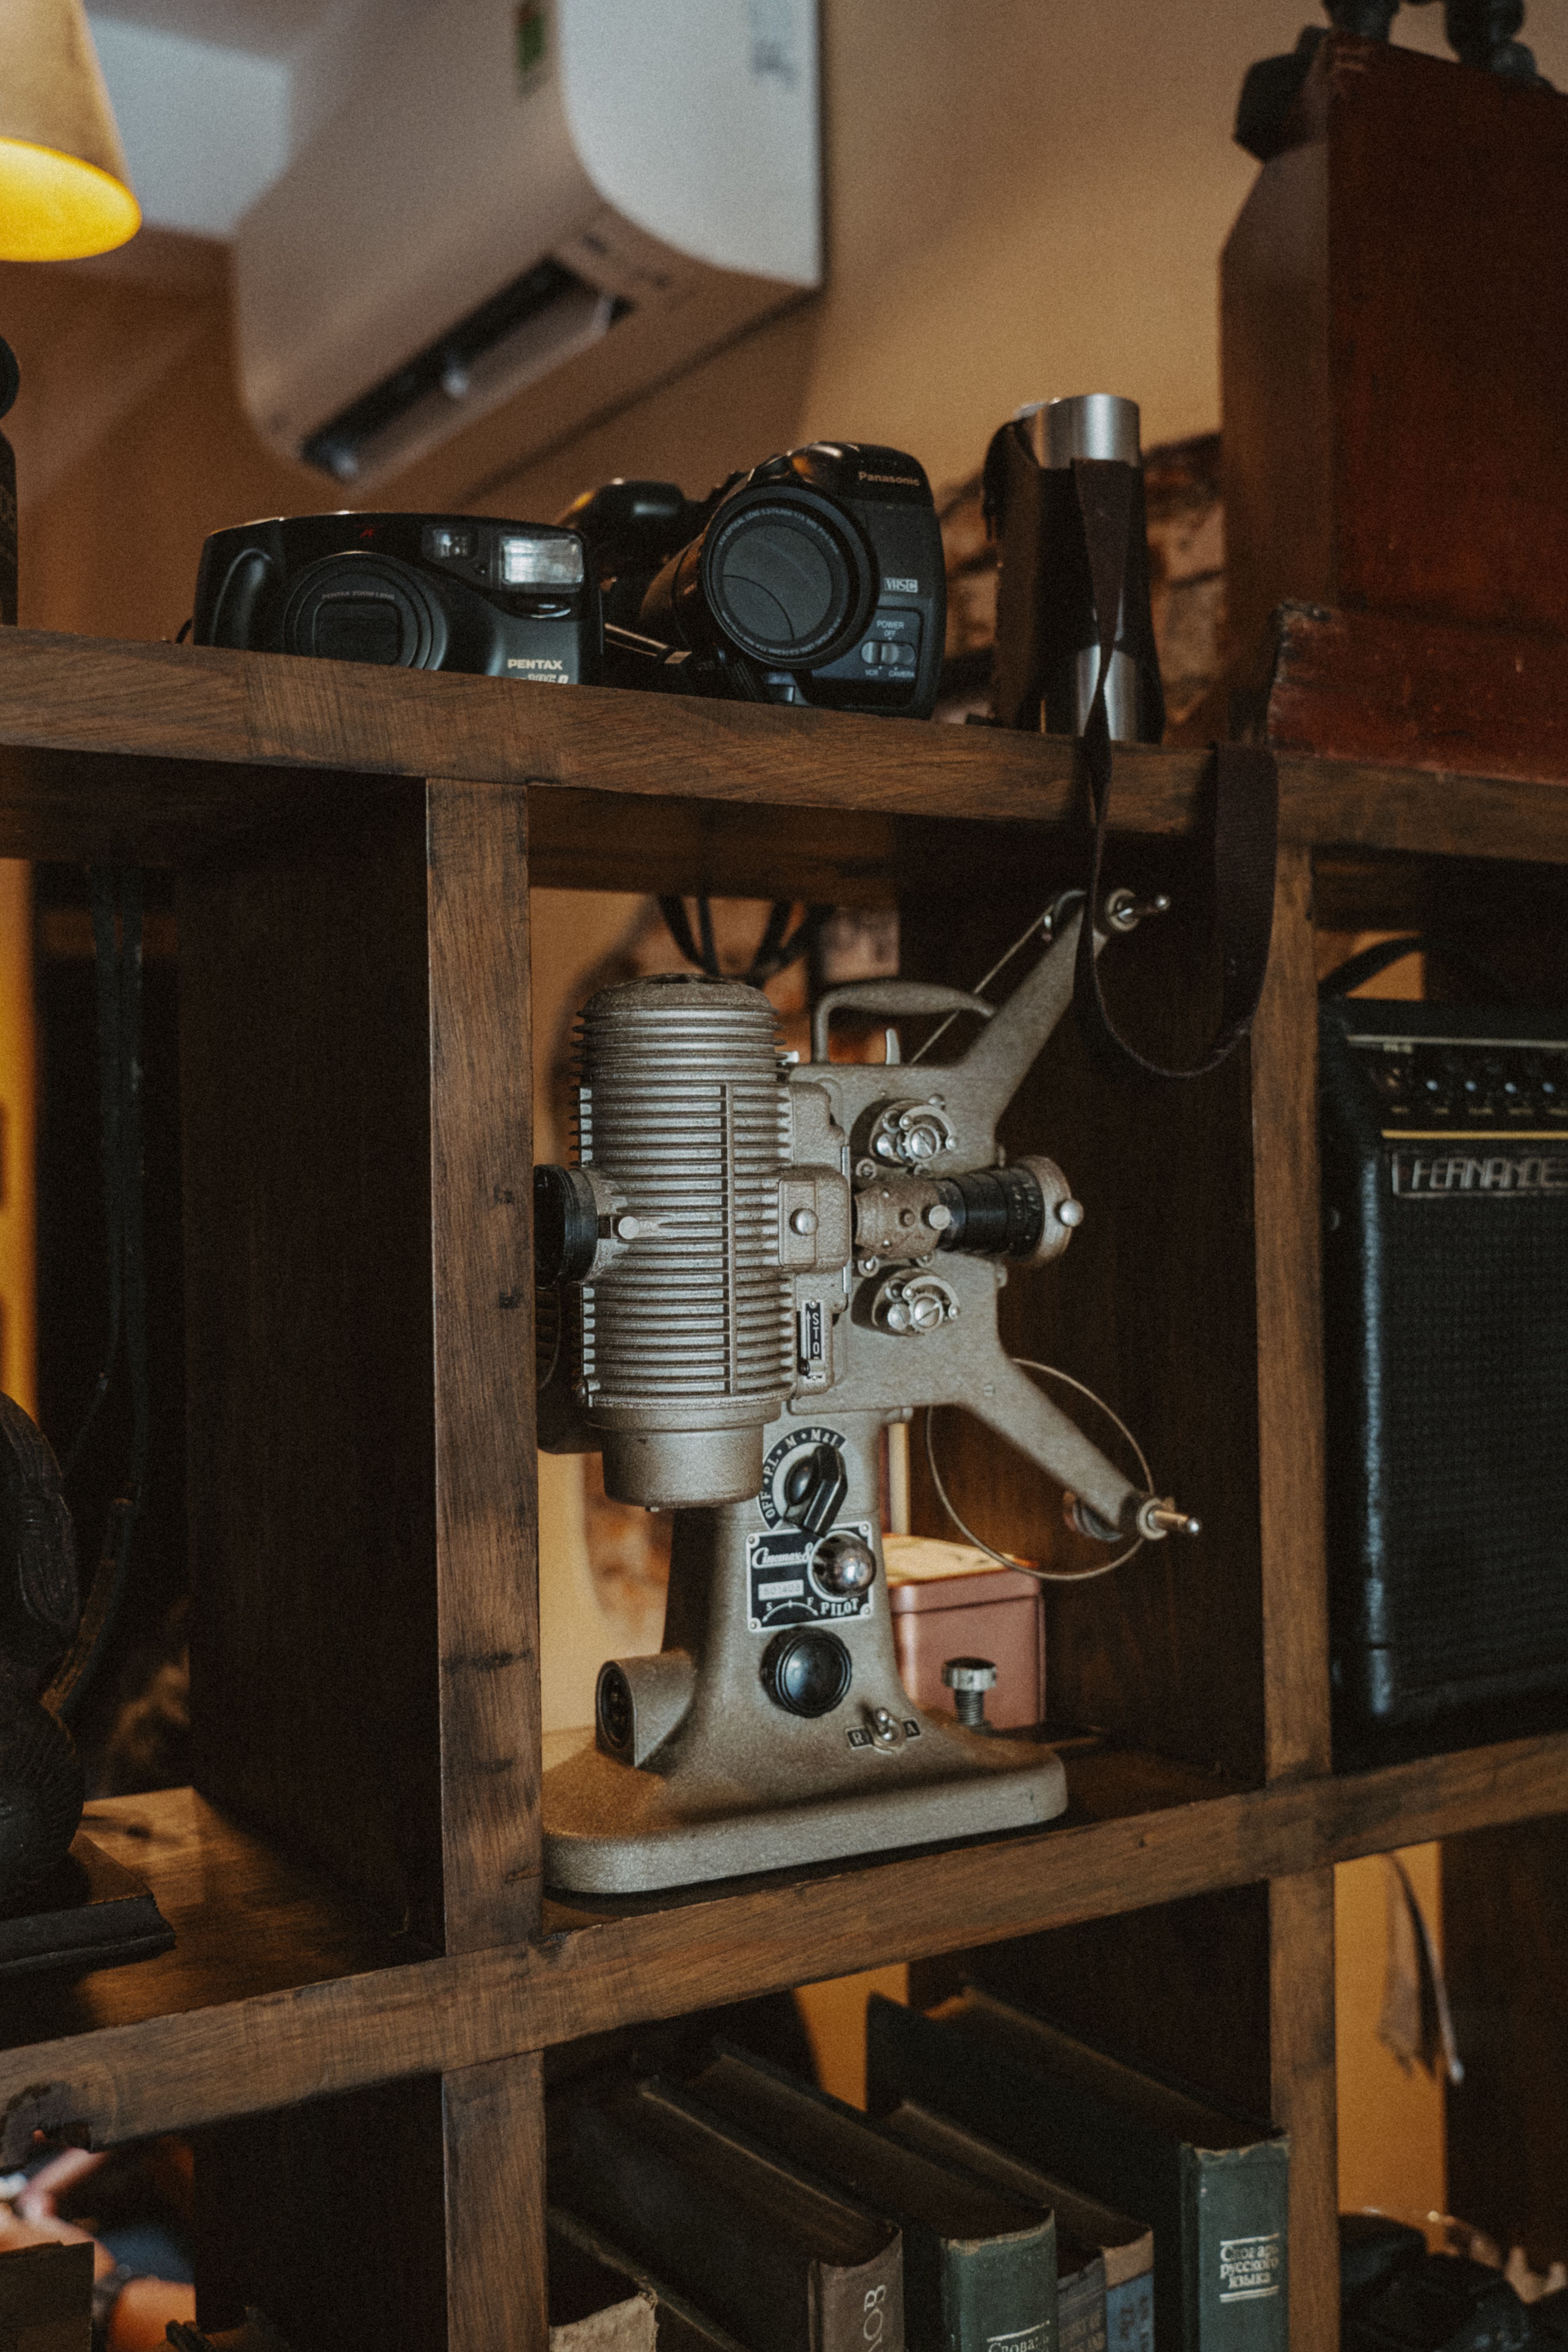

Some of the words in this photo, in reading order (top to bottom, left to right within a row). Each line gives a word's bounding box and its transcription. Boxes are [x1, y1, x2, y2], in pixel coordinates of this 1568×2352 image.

[859, 471, 921, 486] Panasonic
[876, 621, 904, 629] POWER
[507, 659, 563, 670] PENTAX
[760, 1491, 776, 1519] OFF
[785, 1435, 797, 1448] M
[766, 1602, 772, 1611] S
[807, 1597, 813, 1606] F
[821, 1598, 859, 1616] PILOT
[852, 1731, 864, 1744] R
